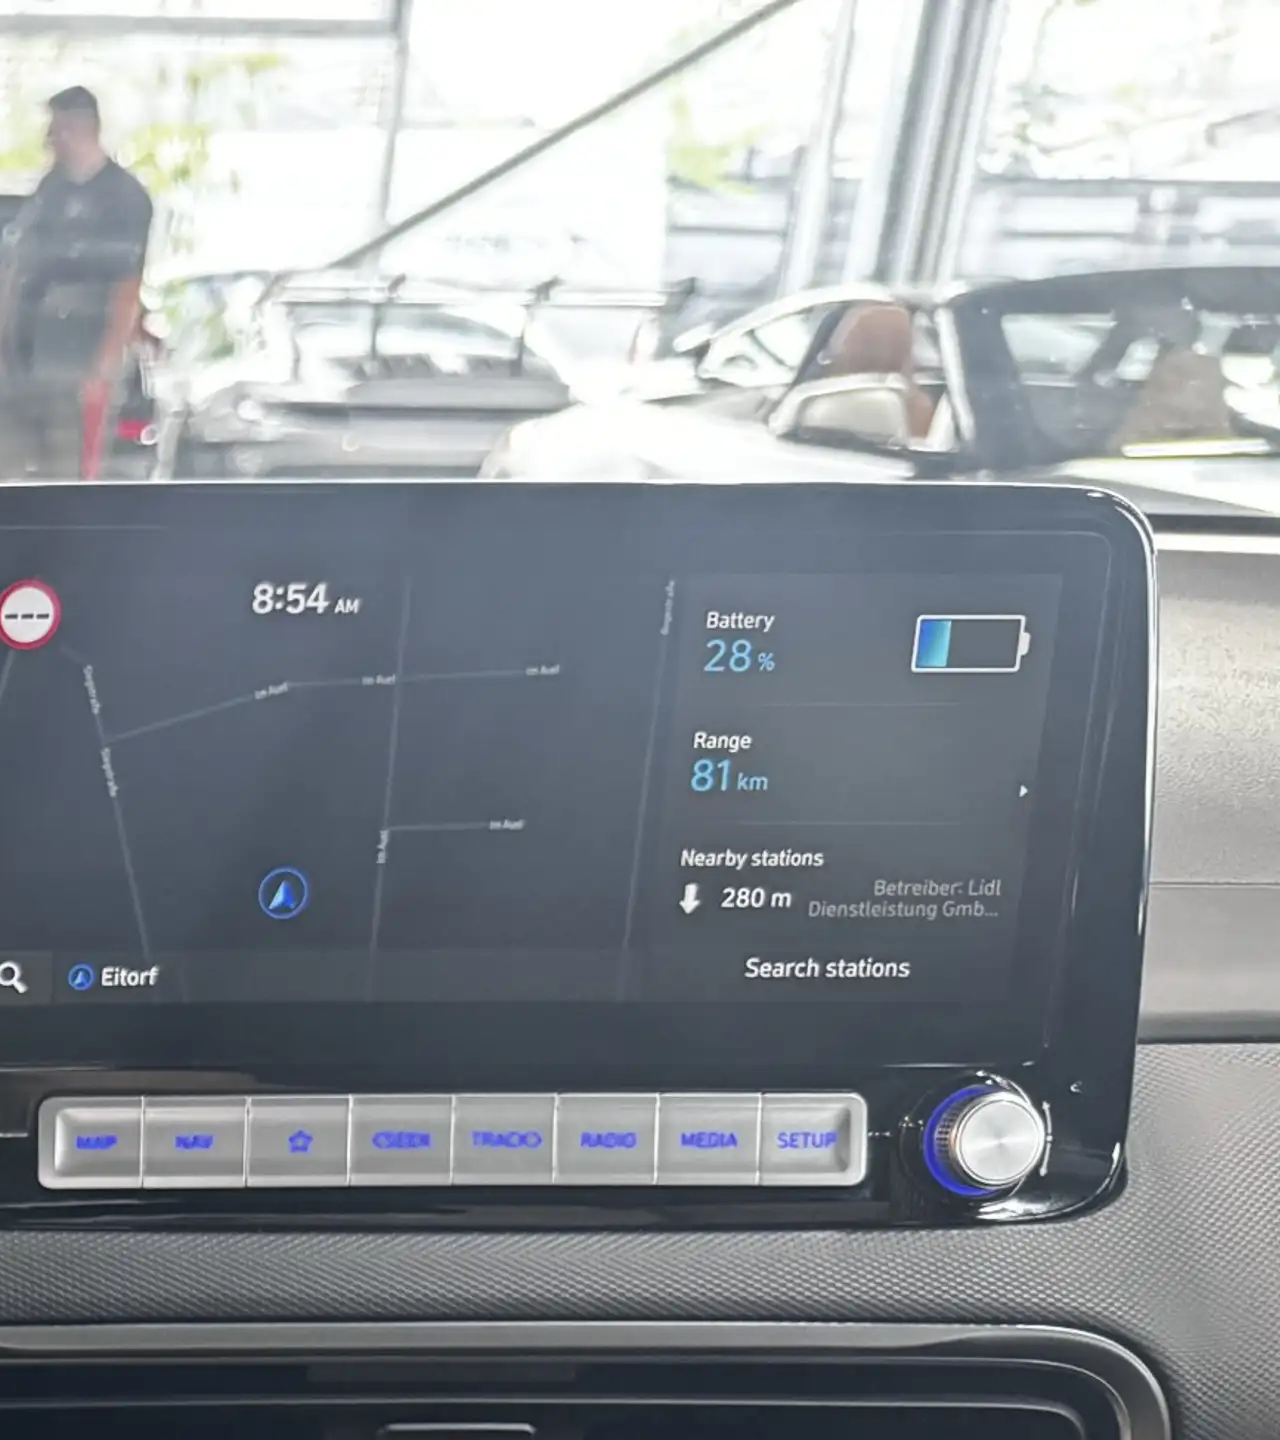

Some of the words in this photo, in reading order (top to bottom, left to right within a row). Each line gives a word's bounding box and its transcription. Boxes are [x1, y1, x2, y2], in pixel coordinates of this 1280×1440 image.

[251, 582, 329, 615] 8:54
[334, 597, 360, 615] AM
[706, 610, 775, 634] Battery
[703, 638, 752, 673] 28
[757, 651, 776, 672] %
[693, 731, 753, 754] Range
[689, 758, 733, 793] 81
[736, 772, 769, 792] km
[680, 848, 748, 871] Nearby
[750, 849, 825, 868] stations
[720, 887, 765, 909] 280
[770, 891, 793, 909] m
[872, 878, 964, 897] Betreiber:
[967, 878, 1002, 897] Lidl
[807, 900, 938, 922] Dienstleistung
[941, 900, 999, 919] Gmb...
[100, 964, 160, 988] Eitorf
[744, 957, 821, 980] Search
[824, 957, 912, 980] stations
[580, 1131, 638, 1149] RADIO
[679, 1131, 739, 1149] MEDIA
[775, 1130, 838, 1150] SETUP
